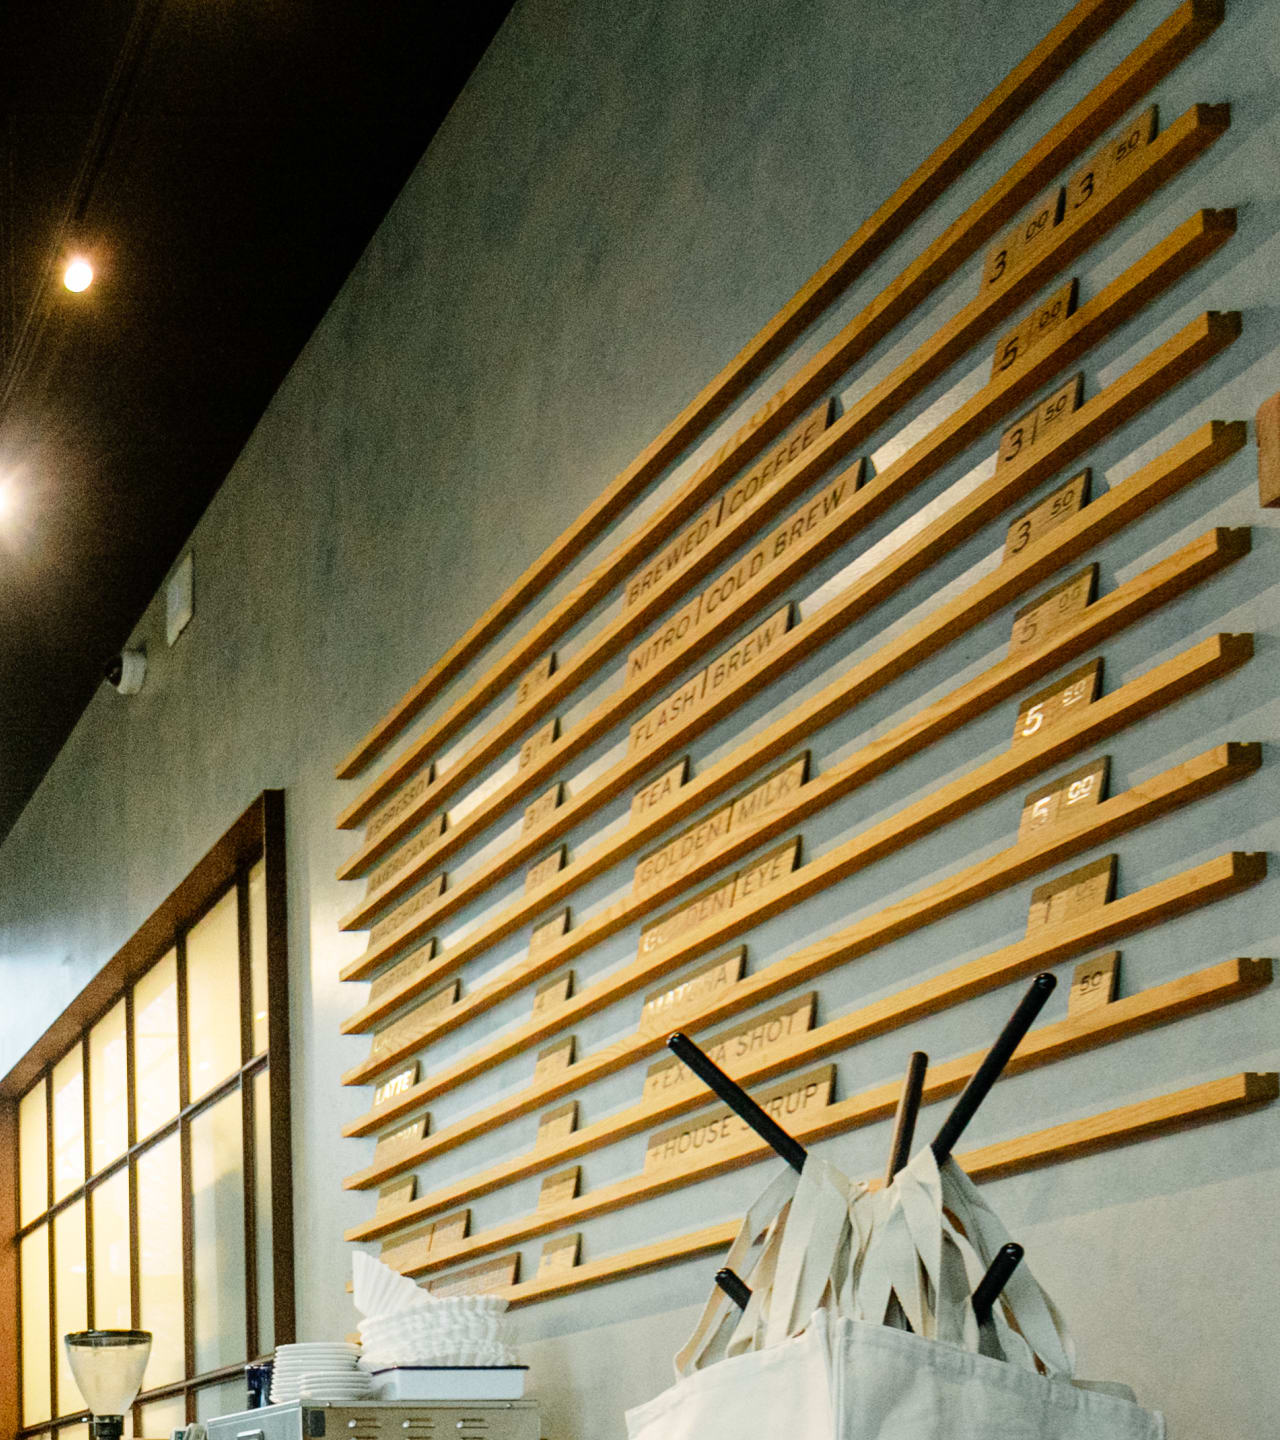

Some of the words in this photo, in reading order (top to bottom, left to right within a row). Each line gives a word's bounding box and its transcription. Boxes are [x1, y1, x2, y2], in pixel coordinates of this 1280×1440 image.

[1074, 172, 1094, 208] 3
[1116, 130, 1140, 161] 50
[989, 250, 1008, 284] 3
[1000, 336, 1020, 371] 5
[1005, 428, 1024, 462] 3
[1044, 394, 1068, 425] 50
[627, 520, 710, 607] BREWED
[729, 421, 817, 515] COFFEE
[1012, 521, 1032, 553] 3
[1051, 490, 1075, 517] 50
[631, 615, 691, 679] NITRO
[706, 552, 764, 614] COLD
[773, 481, 847, 559] BREW
[1020, 611, 1039, 645] 5
[633, 685, 697, 749] FLASH
[713, 621, 779, 689] BREW
[1022, 703, 1045, 737] 5
[639, 776, 672, 814] TEA
[1030, 796, 1052, 832] 5
[640, 816, 723, 884] GOLDEN
[738, 774, 792, 824] MILK
[743, 857, 782, 898] EYE
[1079, 970, 1104, 996] 50
[651, 1044, 728, 1089] +EXA
[736, 1009, 802, 1058] SHOT
[651, 1113, 733, 1160] +HOUSE
[740, 1082, 819, 1131] RUP
